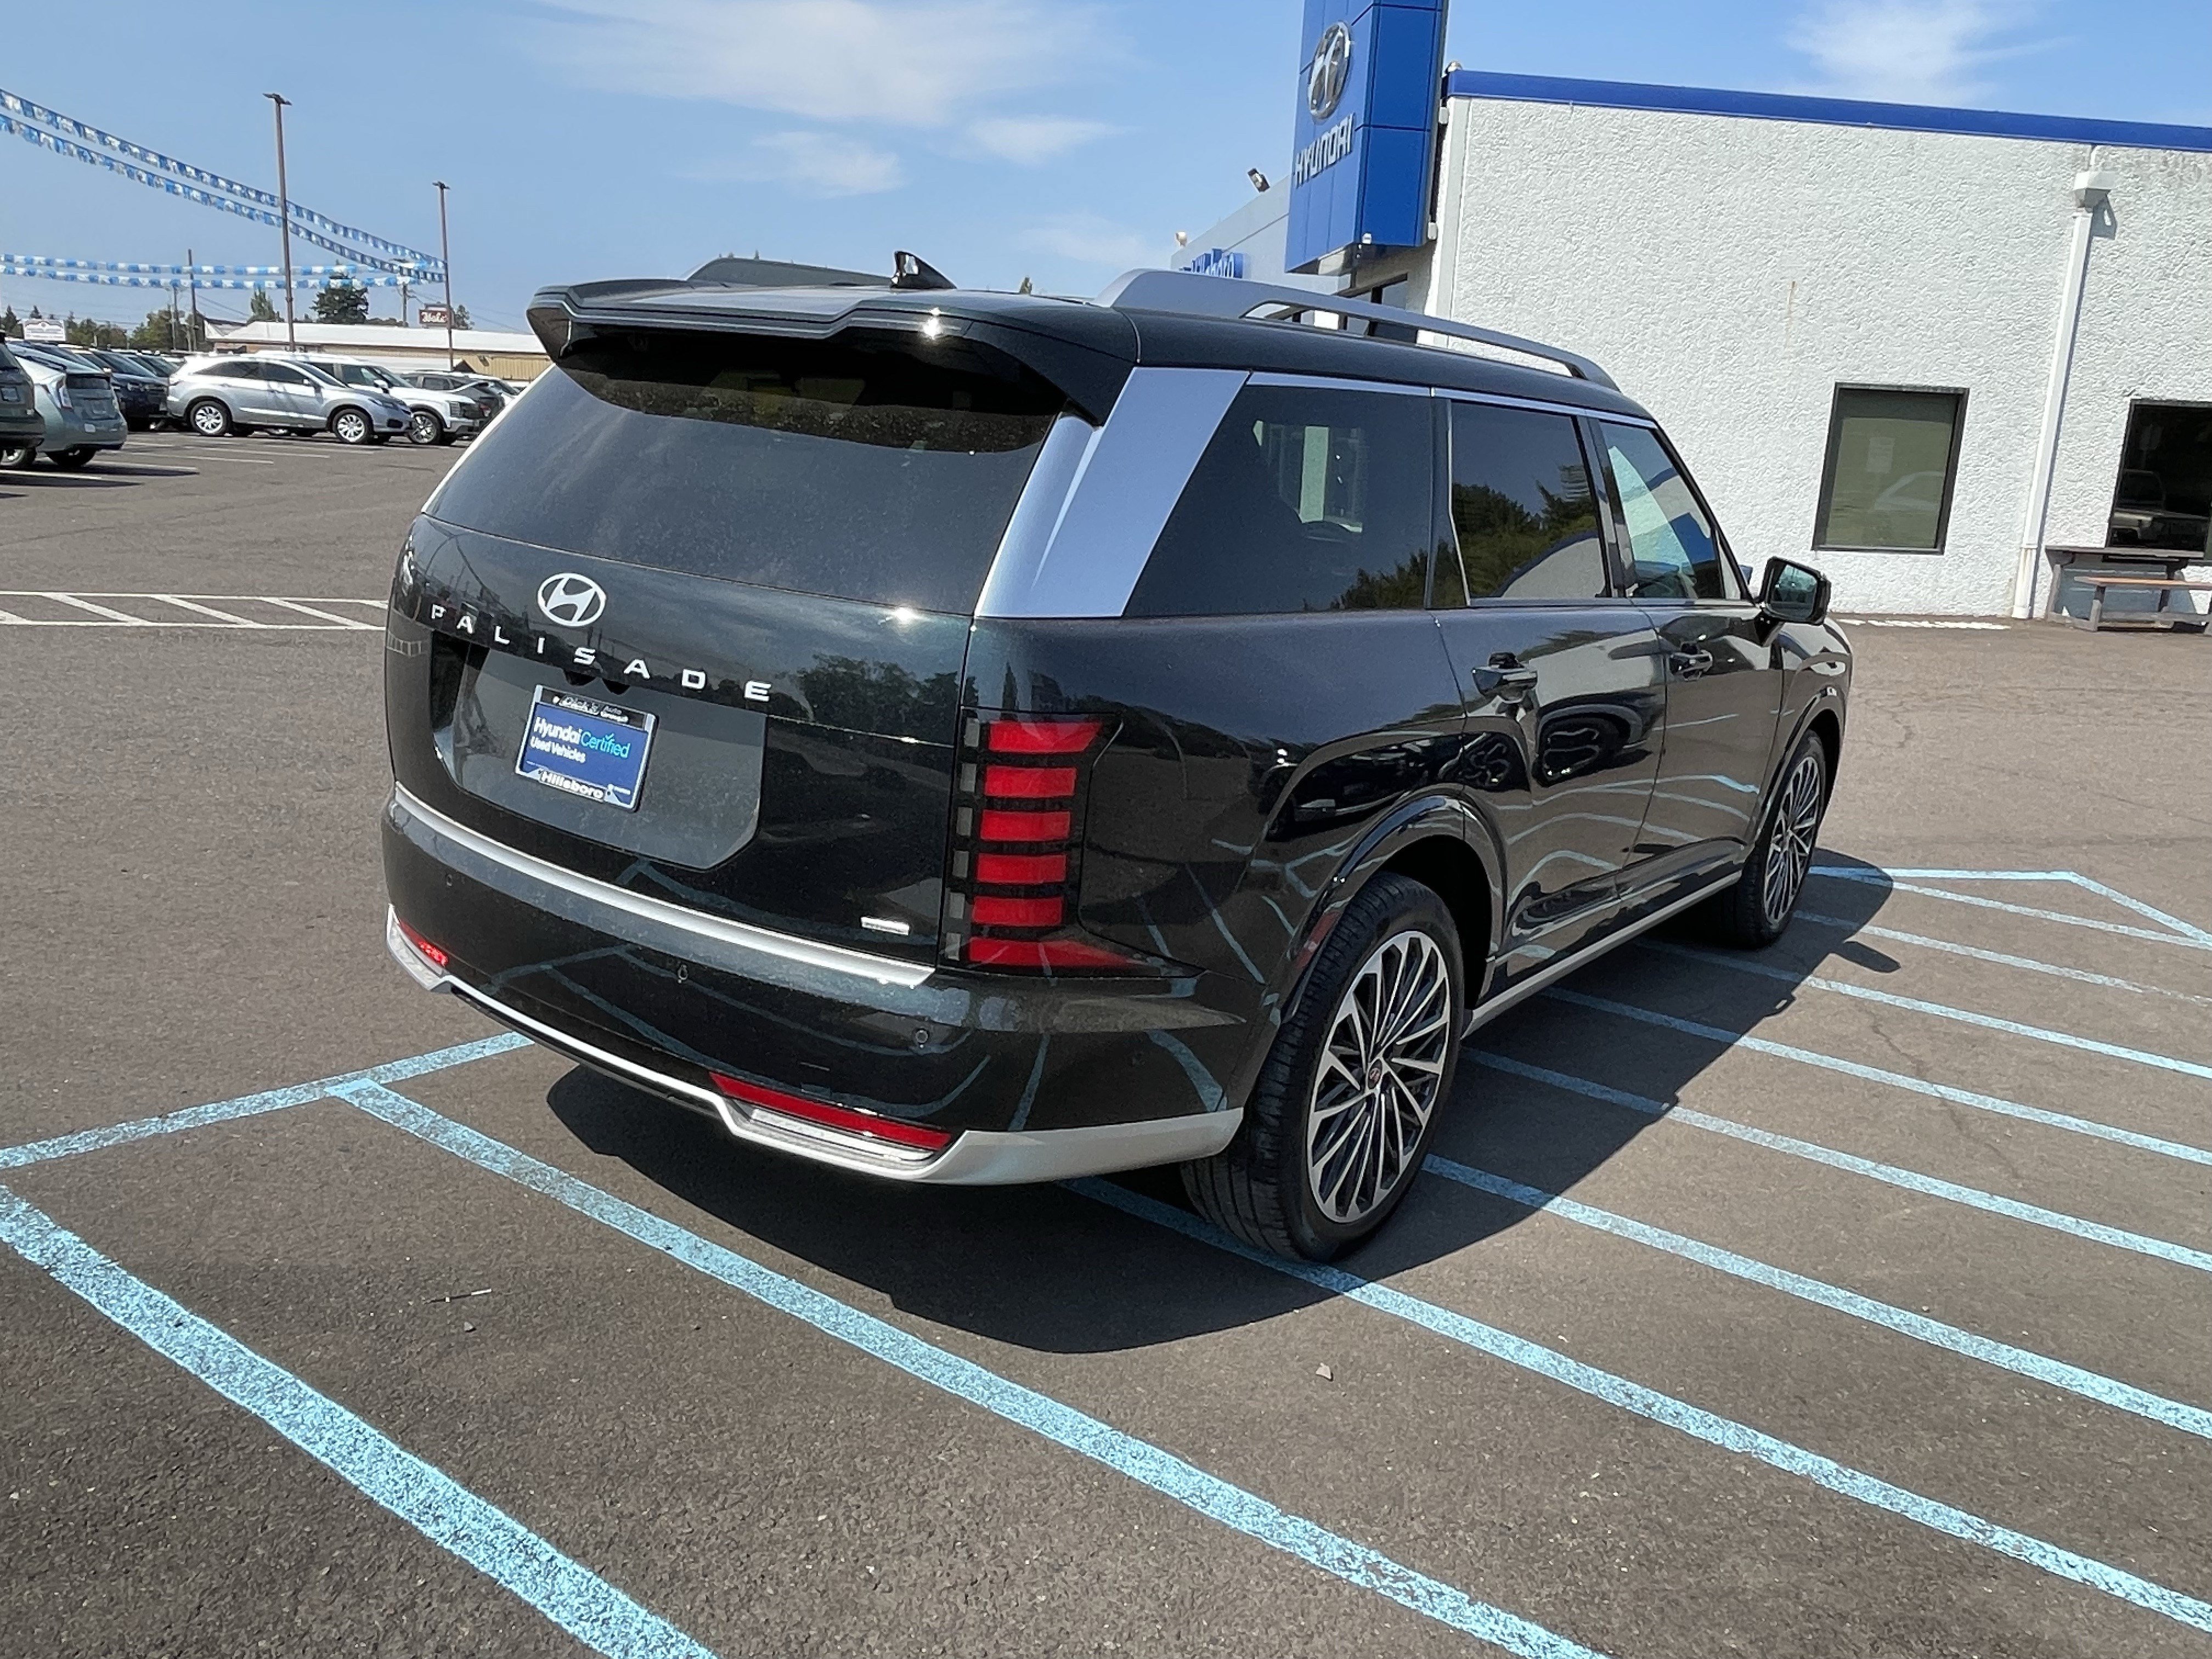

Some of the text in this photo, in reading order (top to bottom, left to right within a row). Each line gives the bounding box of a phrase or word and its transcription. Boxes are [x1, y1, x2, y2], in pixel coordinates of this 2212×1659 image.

[1295, 112, 1354, 185] HYUNDAI
[431, 604, 772, 702] PALISADE
[541, 771, 603, 798] Hillsboro
